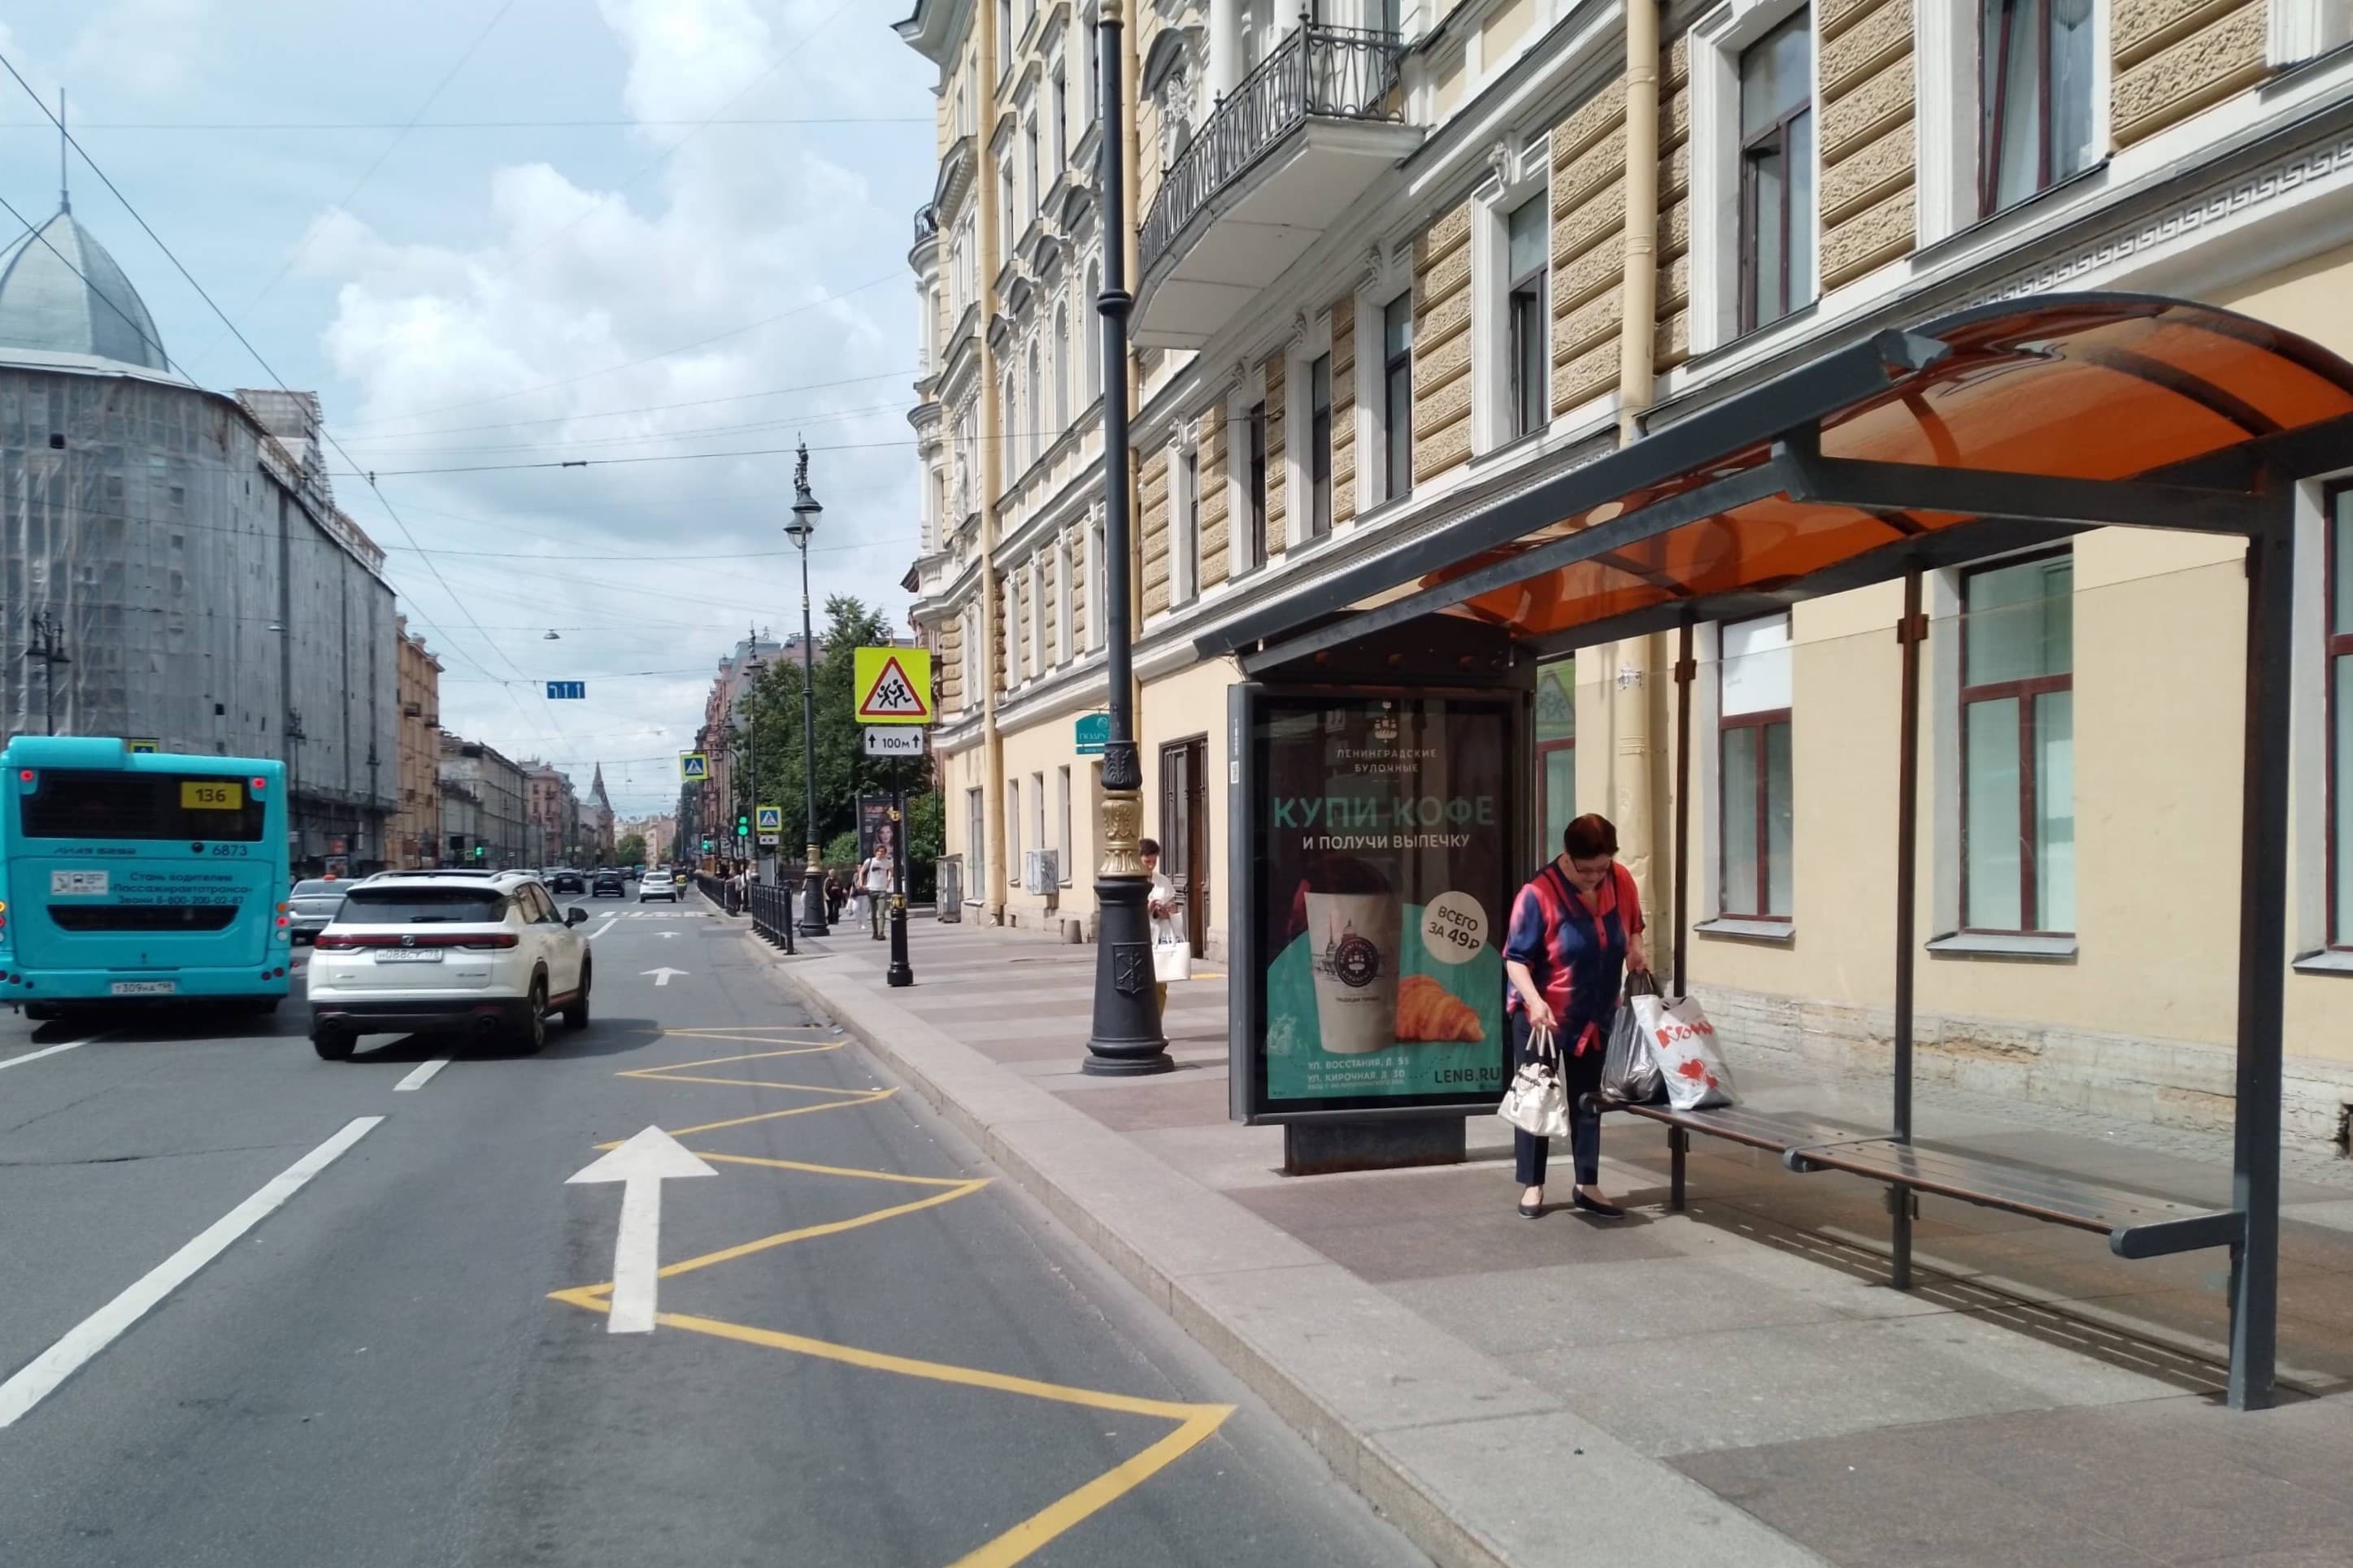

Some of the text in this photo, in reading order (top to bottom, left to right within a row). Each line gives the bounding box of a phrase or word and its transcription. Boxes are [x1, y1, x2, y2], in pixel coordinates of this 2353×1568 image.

[1337, 749, 1437, 759] ЛЕНИНГРАДСКИЕ
[1355, 763, 1419, 773] БУЛОЧНЫЕ
[195, 788, 226, 802] 136
[1274, 796, 1495, 828] КУПИ КОФЕ
[1303, 834, 1471, 850] И ПОЛУЧИ ВЫПЕЧКУ
[212, 845, 248, 856] 6873
[1438, 906, 1478, 931] ВСЕГО
[1428, 921, 1444, 938] ЗА
[1307, 1062, 1322, 1070] УЛ.
[1307, 1074, 1322, 1083] УЛ.
[1393, 1069, 1405, 1078] 30
[1434, 1066, 1500, 1084] LENB.RU
